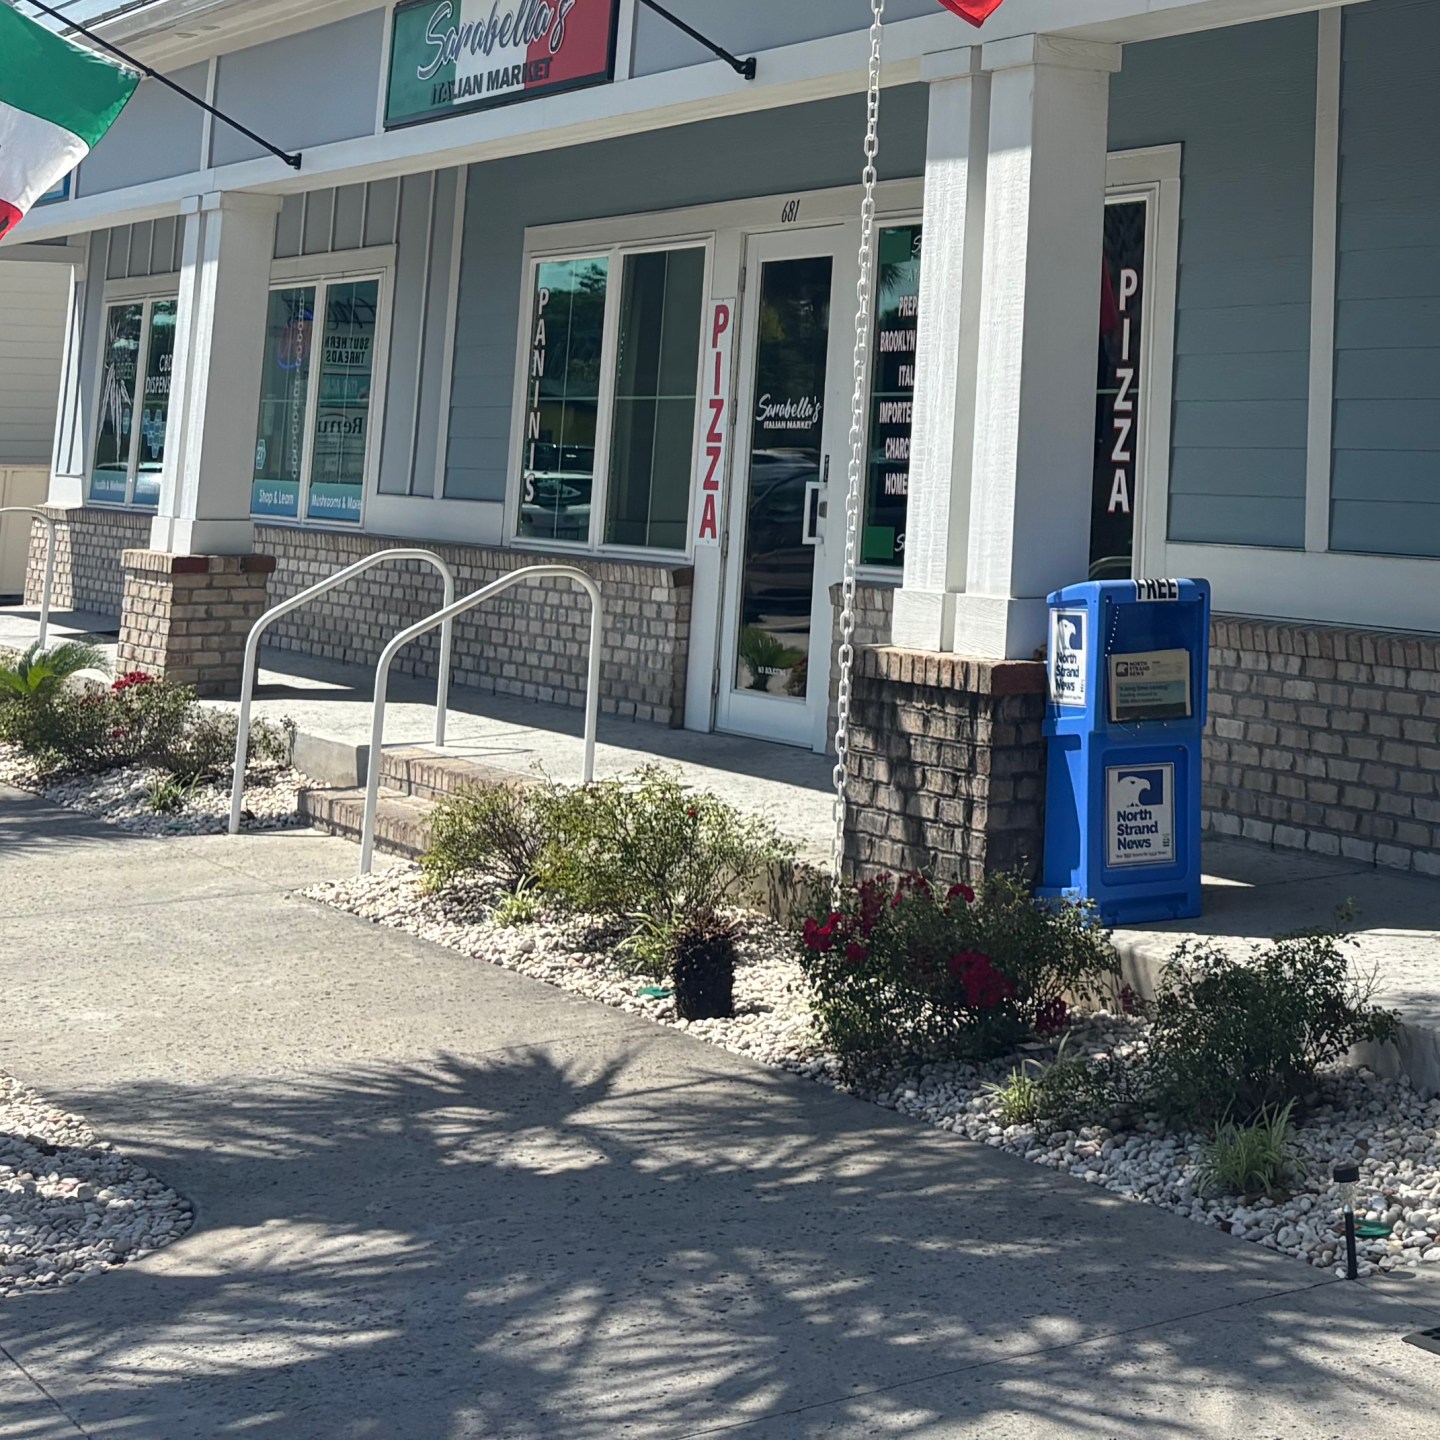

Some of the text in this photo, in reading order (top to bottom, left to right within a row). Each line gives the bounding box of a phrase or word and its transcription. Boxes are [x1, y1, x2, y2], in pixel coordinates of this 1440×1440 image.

[431, 57, 553, 105] ITALIAN MARKET
[781, 199, 800, 223] 681
[898, 295, 919, 317] PREP
[879, 329, 916, 353] BROOKLYN
[524, 288, 549, 502] PANINIS
[1107, 268, 1138, 513] PIZZA
[756, 393, 822, 423] Sarabella's
[879, 401, 913, 424] IMPORTE
[699, 304, 730, 540] PIZZA
[764, 421, 812, 429] ITALIAN MARKET
[885, 437, 910, 459] CHARC
[885, 472, 909, 495] HOME
[1137, 578, 1177, 600] FREE
[1056, 652, 1077, 664] North
[1056, 664, 1080, 678] Strand
[1056, 679, 1075, 691] News
[1117, 808, 1153, 823] North
[1117, 821, 1159, 837] Strand
[1117, 837, 1152, 851] News
